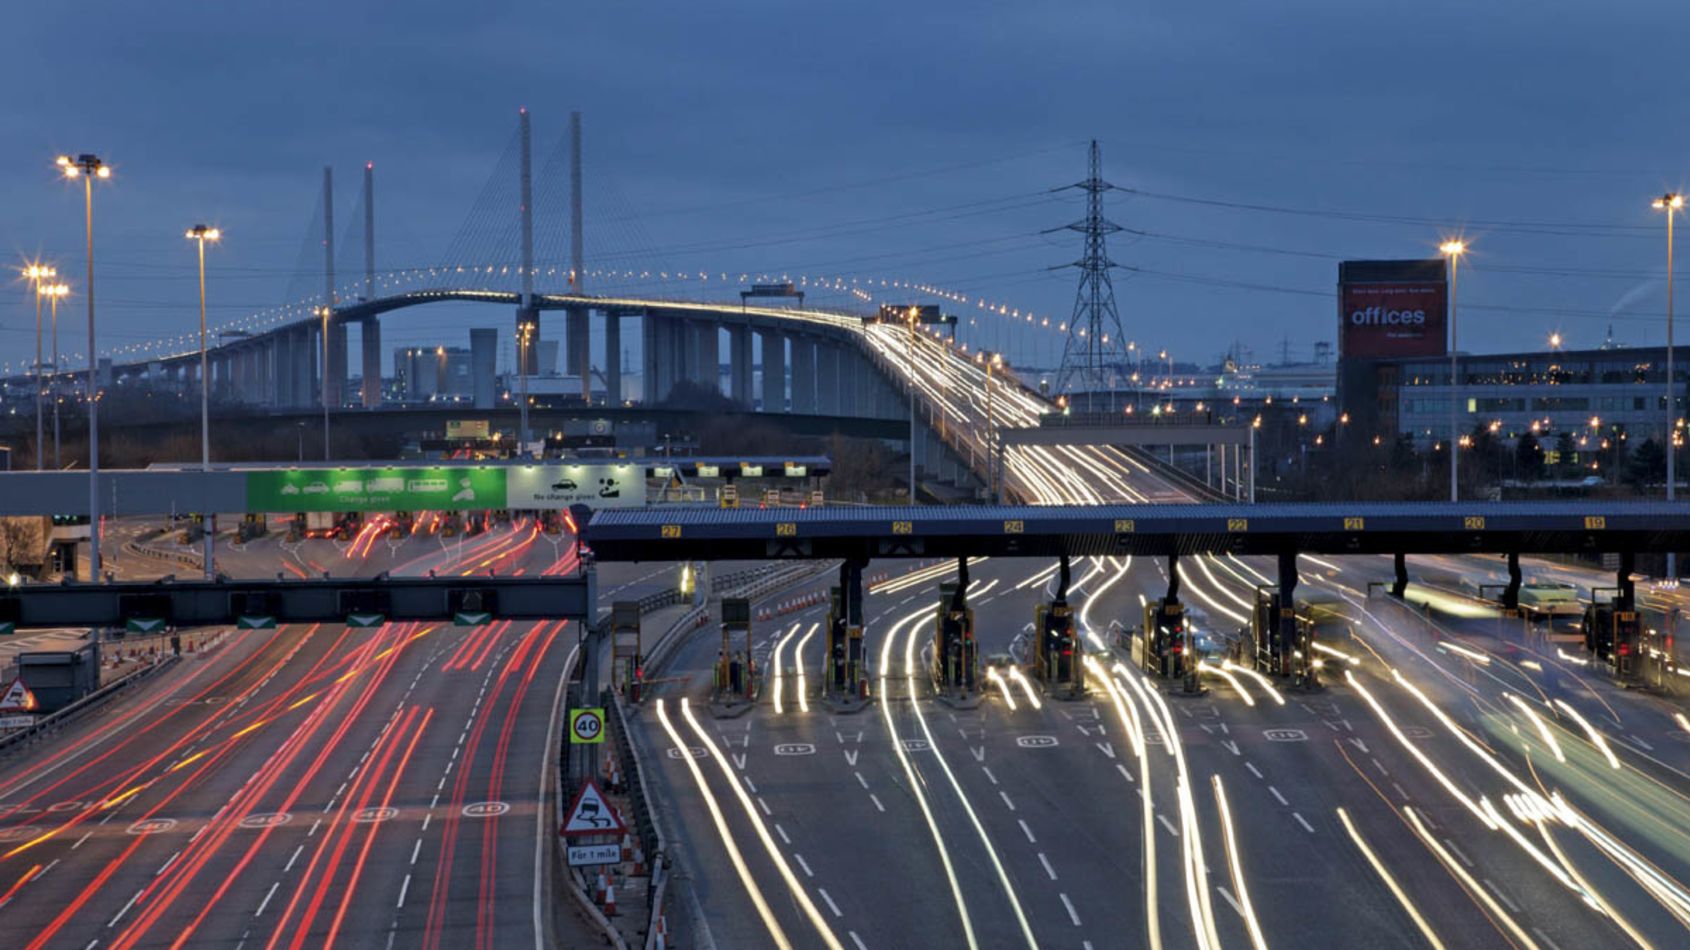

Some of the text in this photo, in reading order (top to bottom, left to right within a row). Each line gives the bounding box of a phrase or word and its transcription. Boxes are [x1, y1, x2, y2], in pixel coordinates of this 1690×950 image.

[1352, 306, 1425, 325] offices
[533, 493, 545, 501] No
[893, 521, 912, 533] 25
[1005, 520, 1022, 532] 24
[1115, 519, 1133, 531] 23
[1465, 517, 1483, 529] 20
[1586, 516, 1604, 529] 19
[662, 526, 680, 537] 27
[777, 524, 796, 536] 26
[577, 719, 599, 732] 40
[469, 805, 502, 814] 40
[597, 848, 616, 860] mile
